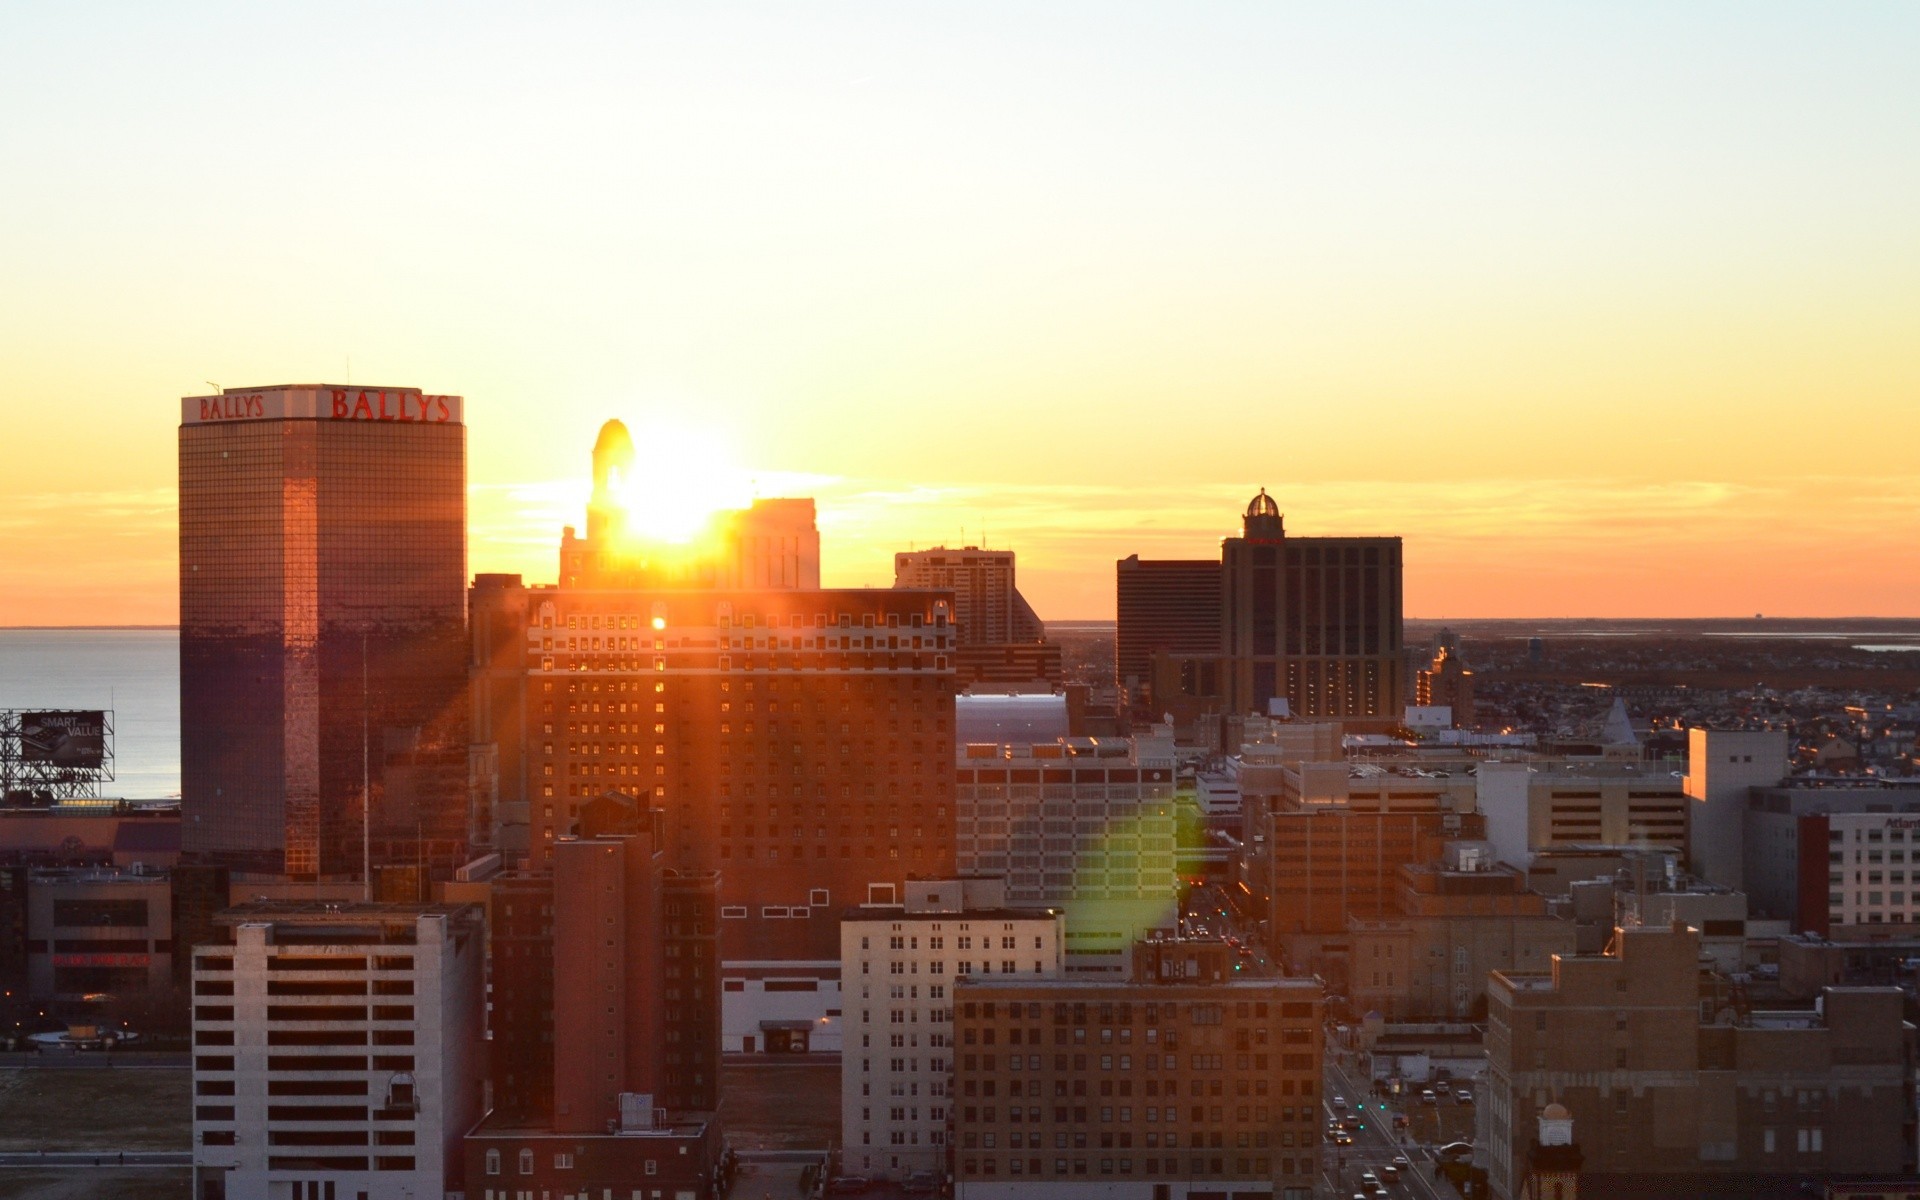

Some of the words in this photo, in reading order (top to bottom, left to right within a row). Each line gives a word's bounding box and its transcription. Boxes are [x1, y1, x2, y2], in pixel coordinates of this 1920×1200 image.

[201, 395, 264, 420] BALLYS
[331, 389, 449, 422] BALLYS
[41, 717, 77, 727] SMART
[67, 727, 101, 736] VALUE
